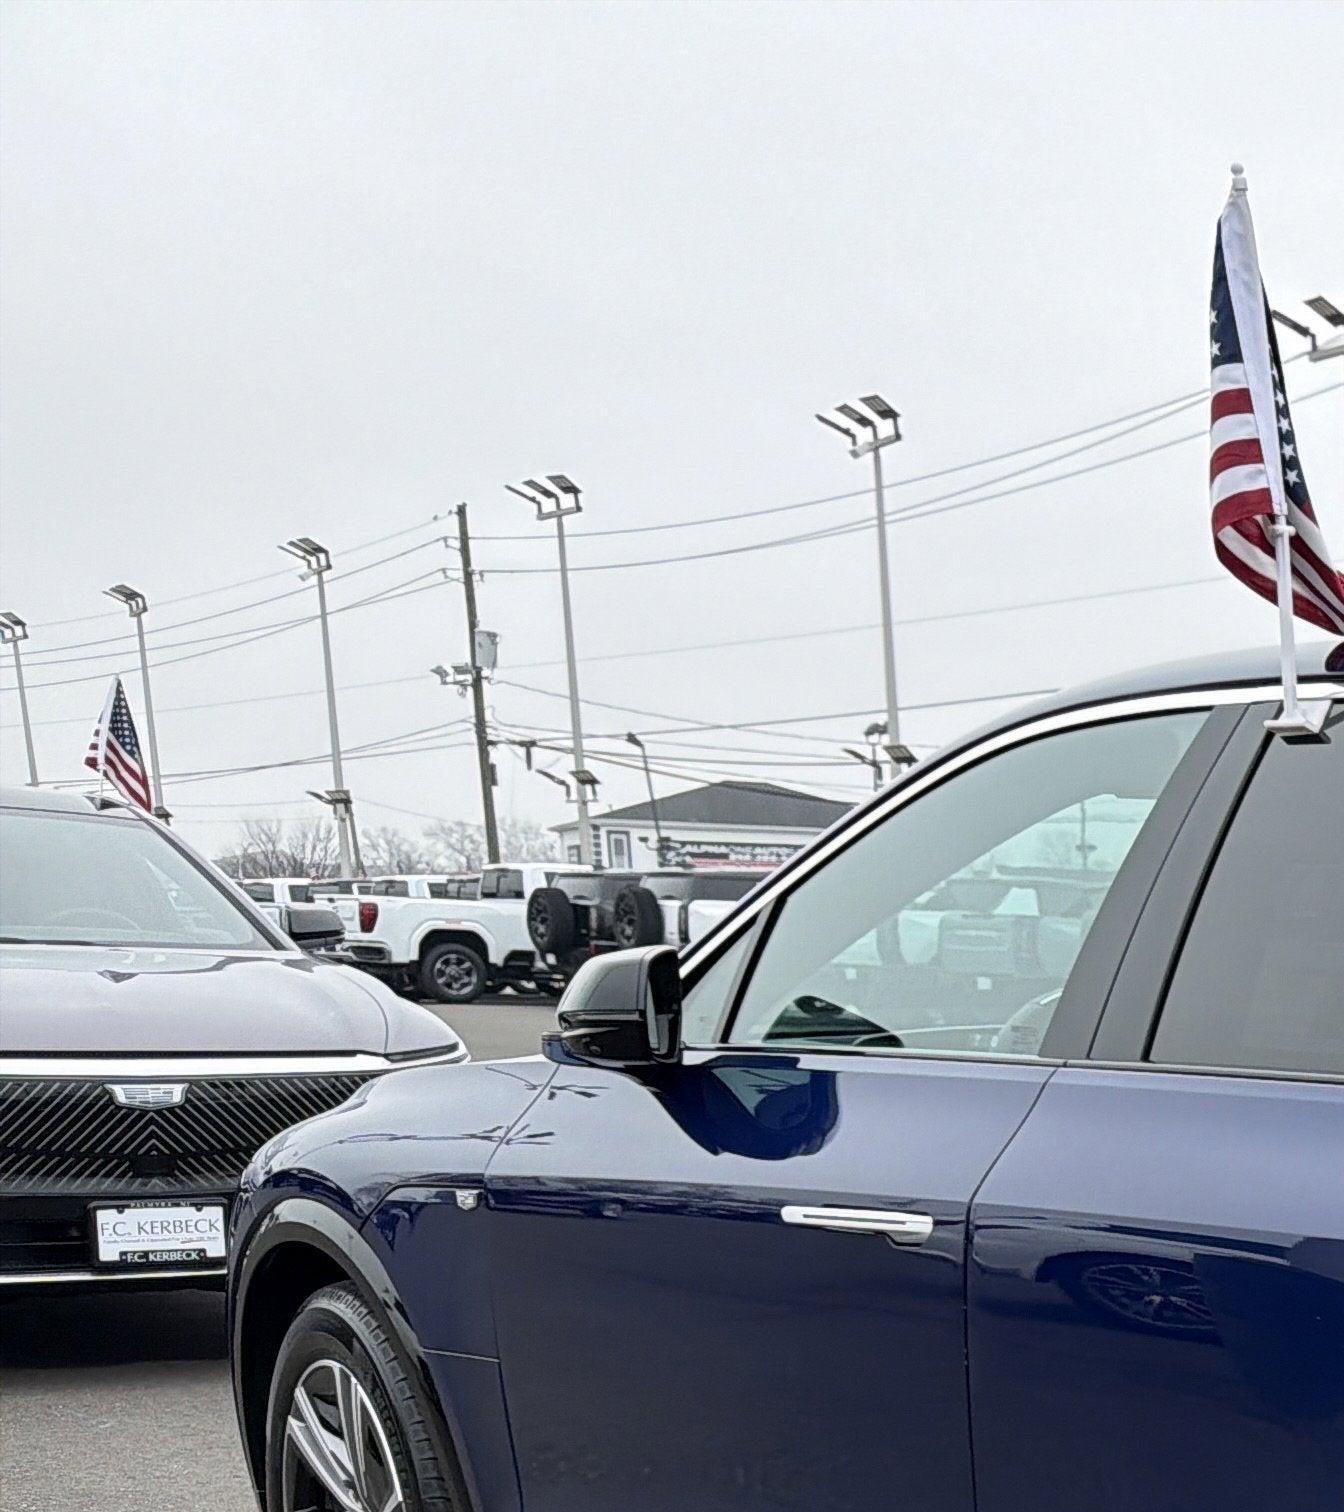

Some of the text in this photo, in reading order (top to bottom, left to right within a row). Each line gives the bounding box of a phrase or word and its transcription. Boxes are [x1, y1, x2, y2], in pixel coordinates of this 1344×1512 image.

[100, 1218, 220, 1237] F.C. KERBECK
[127, 1250, 200, 1262] F.C. KERBECK
